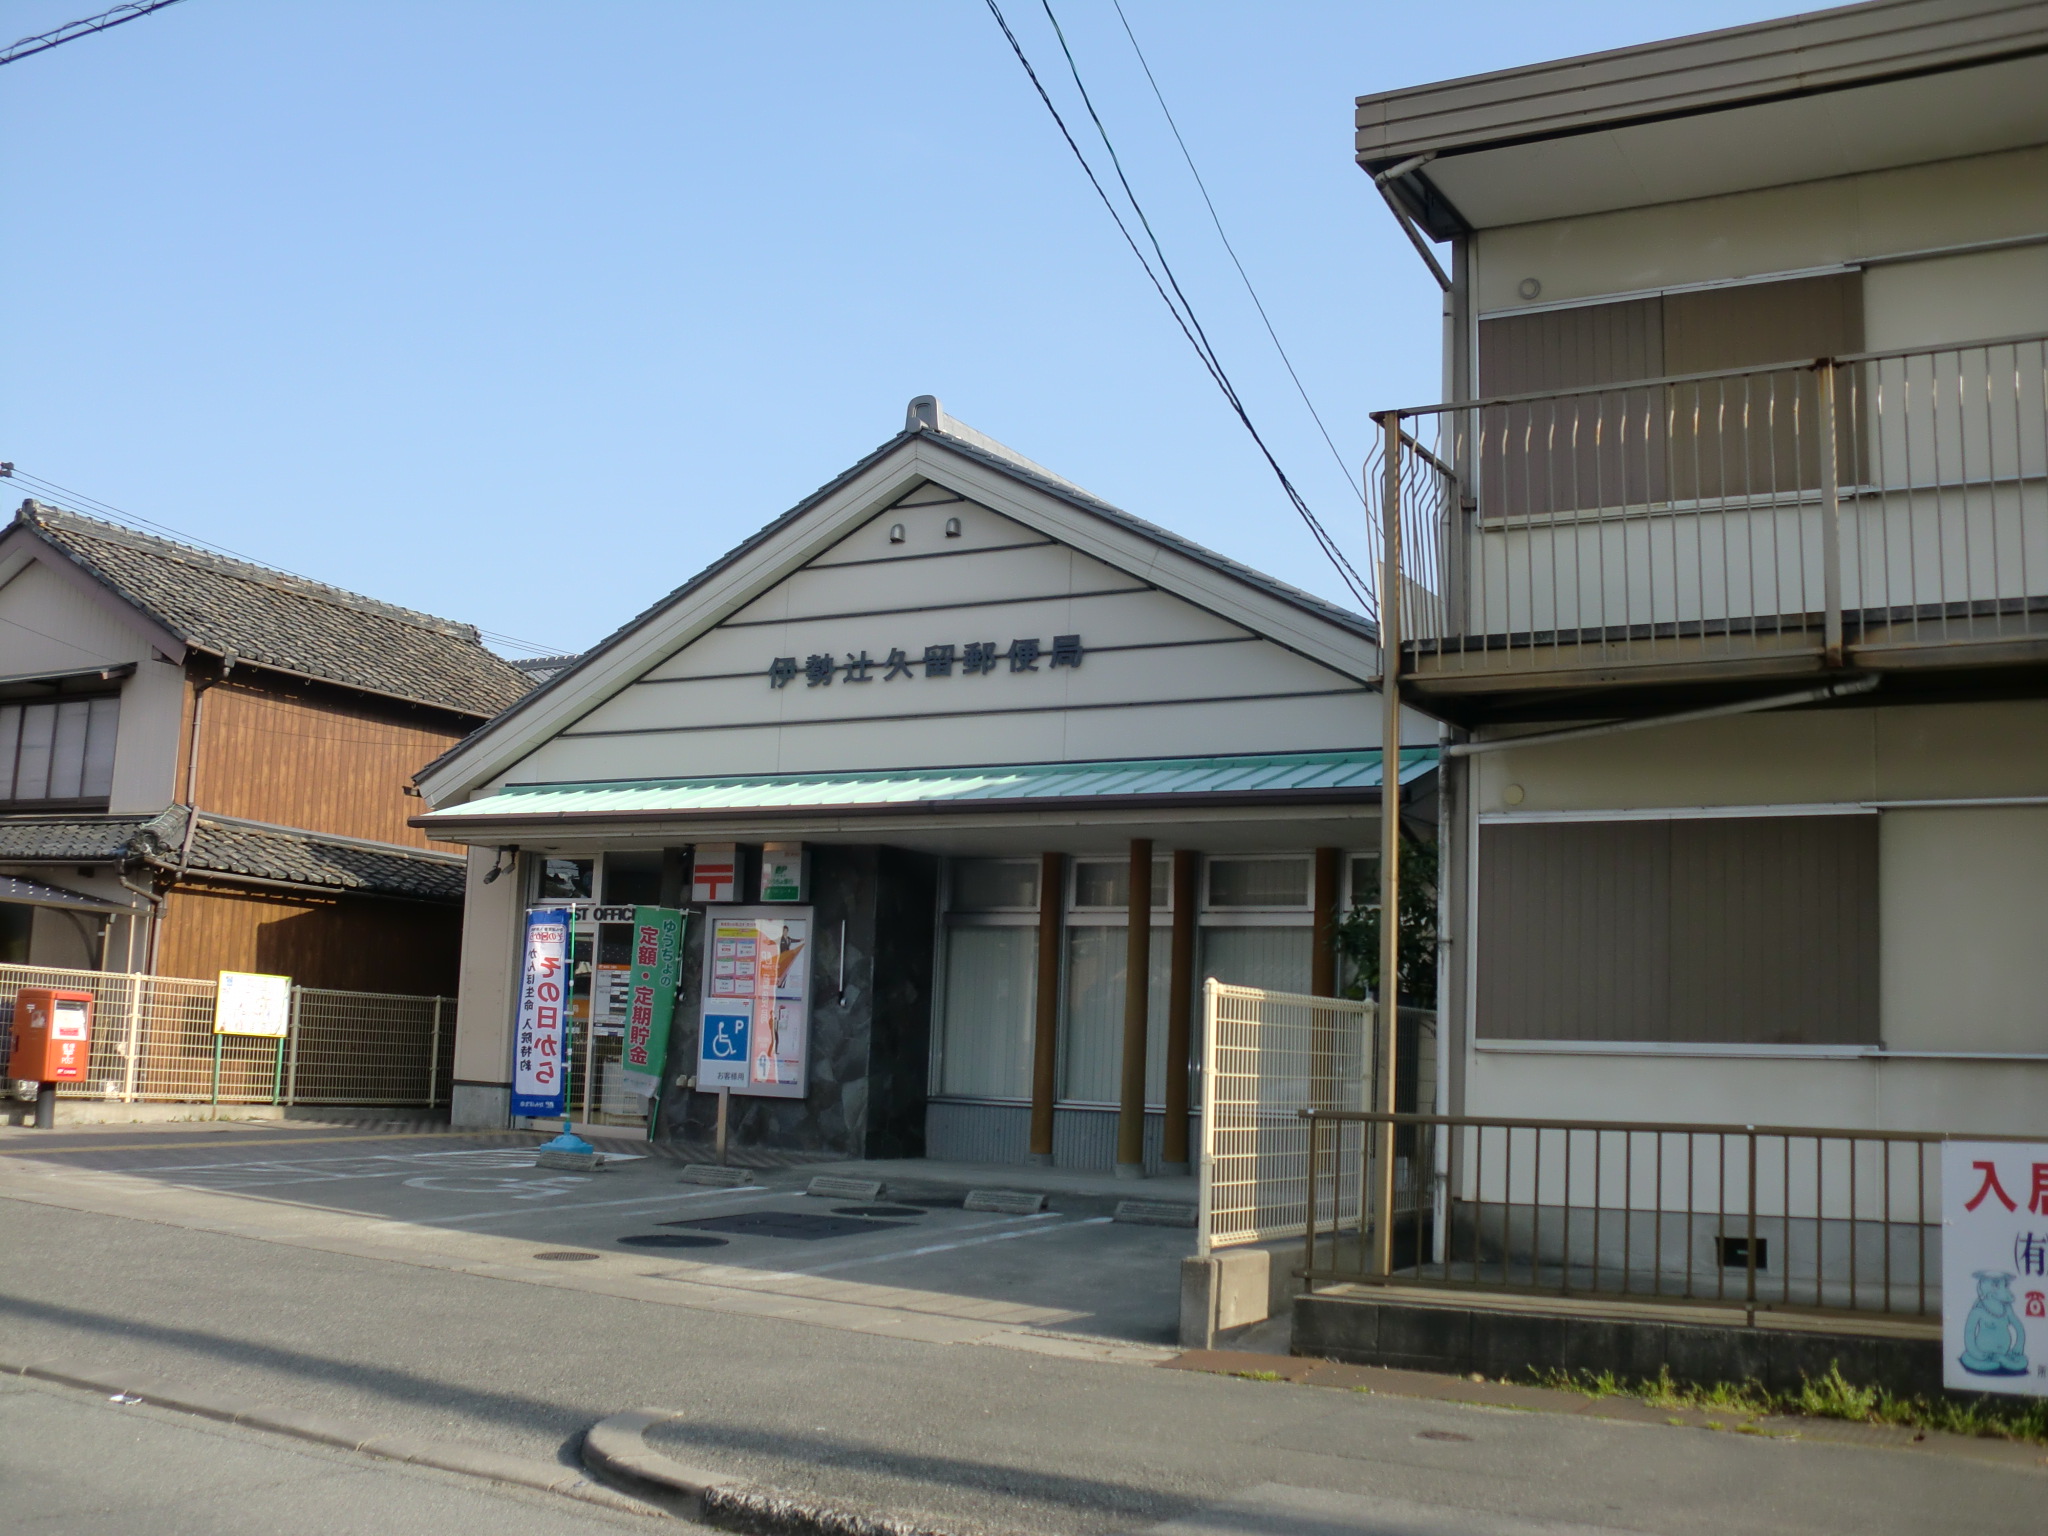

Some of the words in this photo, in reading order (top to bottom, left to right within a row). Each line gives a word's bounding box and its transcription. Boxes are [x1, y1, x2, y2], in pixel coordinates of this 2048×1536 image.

[768, 634, 1083, 689] 伊勢辻久留郵便局
[660, 920, 677, 986] ゆうちょの
[629, 926, 659, 1065] 定額・定期貯金
[735, 1019, 744, 1034] P
